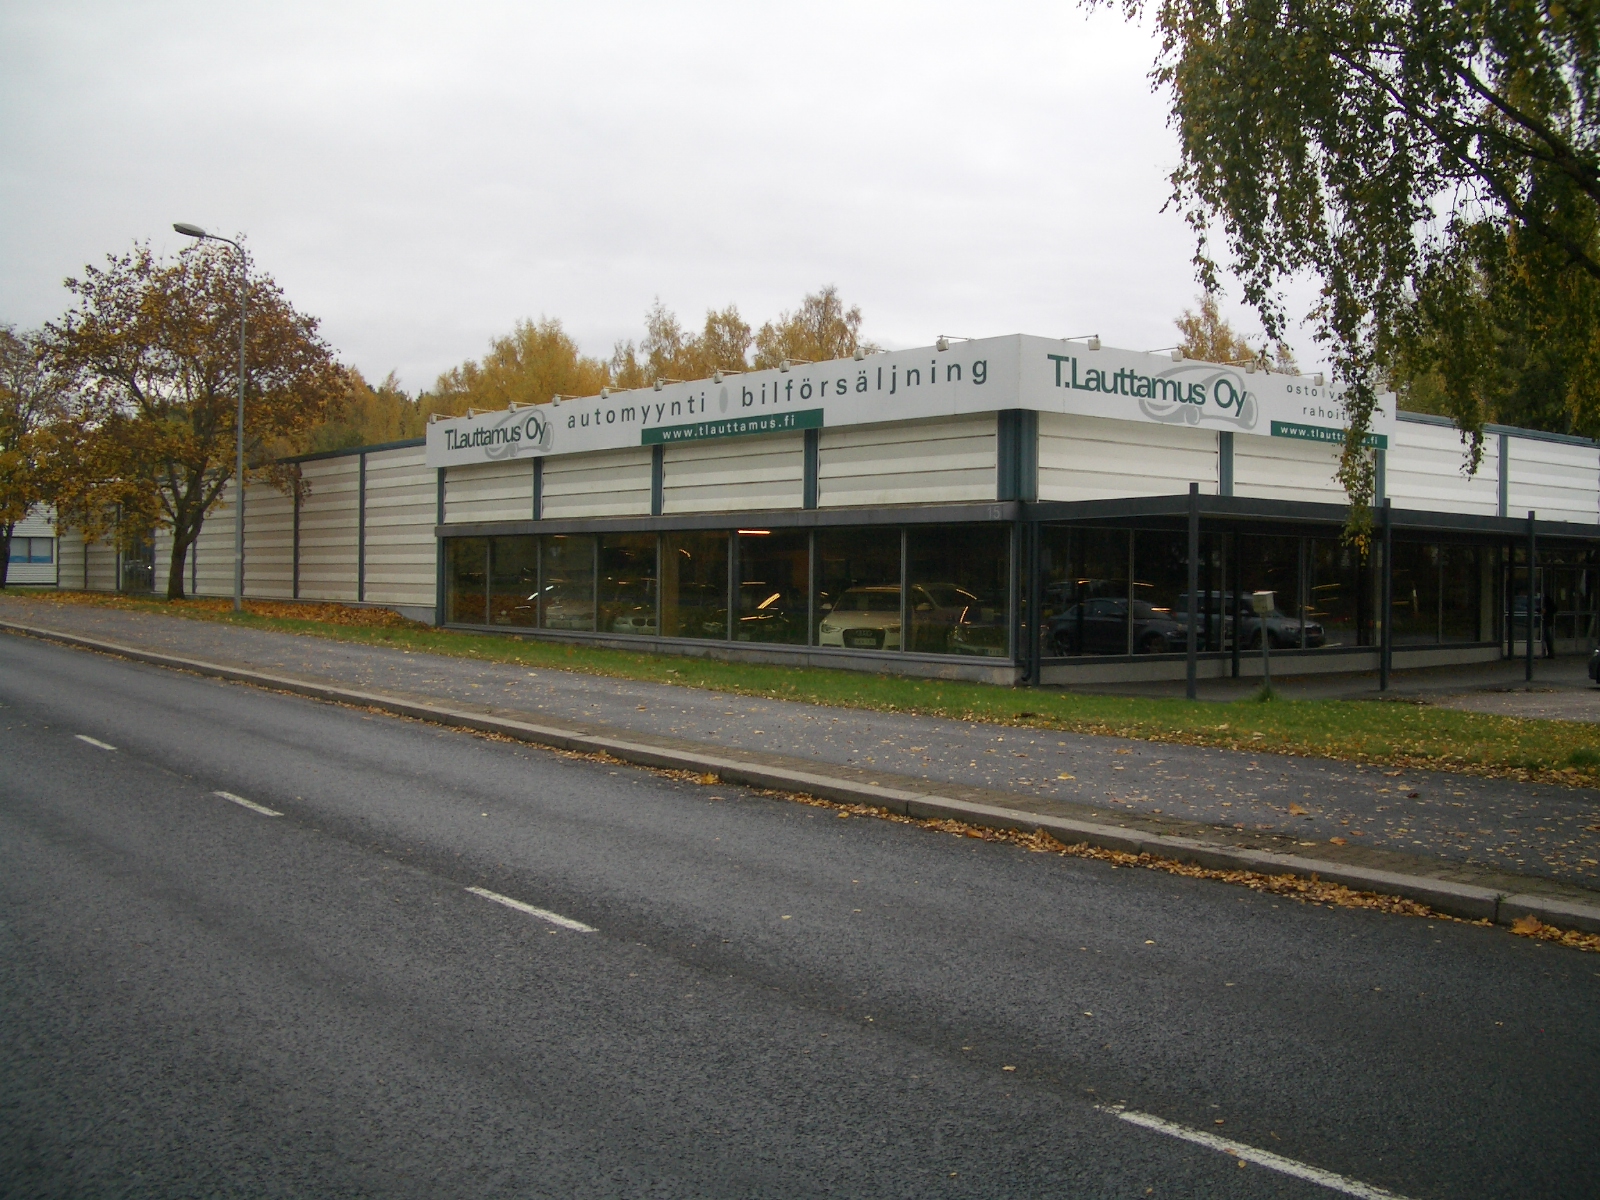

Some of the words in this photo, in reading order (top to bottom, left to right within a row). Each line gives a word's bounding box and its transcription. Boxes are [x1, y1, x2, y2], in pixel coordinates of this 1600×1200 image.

[567, 391, 706, 429] automyynti
[741, 359, 988, 408] bilförsäljning
[1047, 353, 1207, 406] T.Lauttamus
[1213, 378, 1248, 418] Oy
[1286, 383, 1318, 398] osto
[444, 424, 522, 451] T.Lauttamus
[525, 416, 547, 445] Oy
[662, 414, 795, 440] www.tlauttamus.fi
